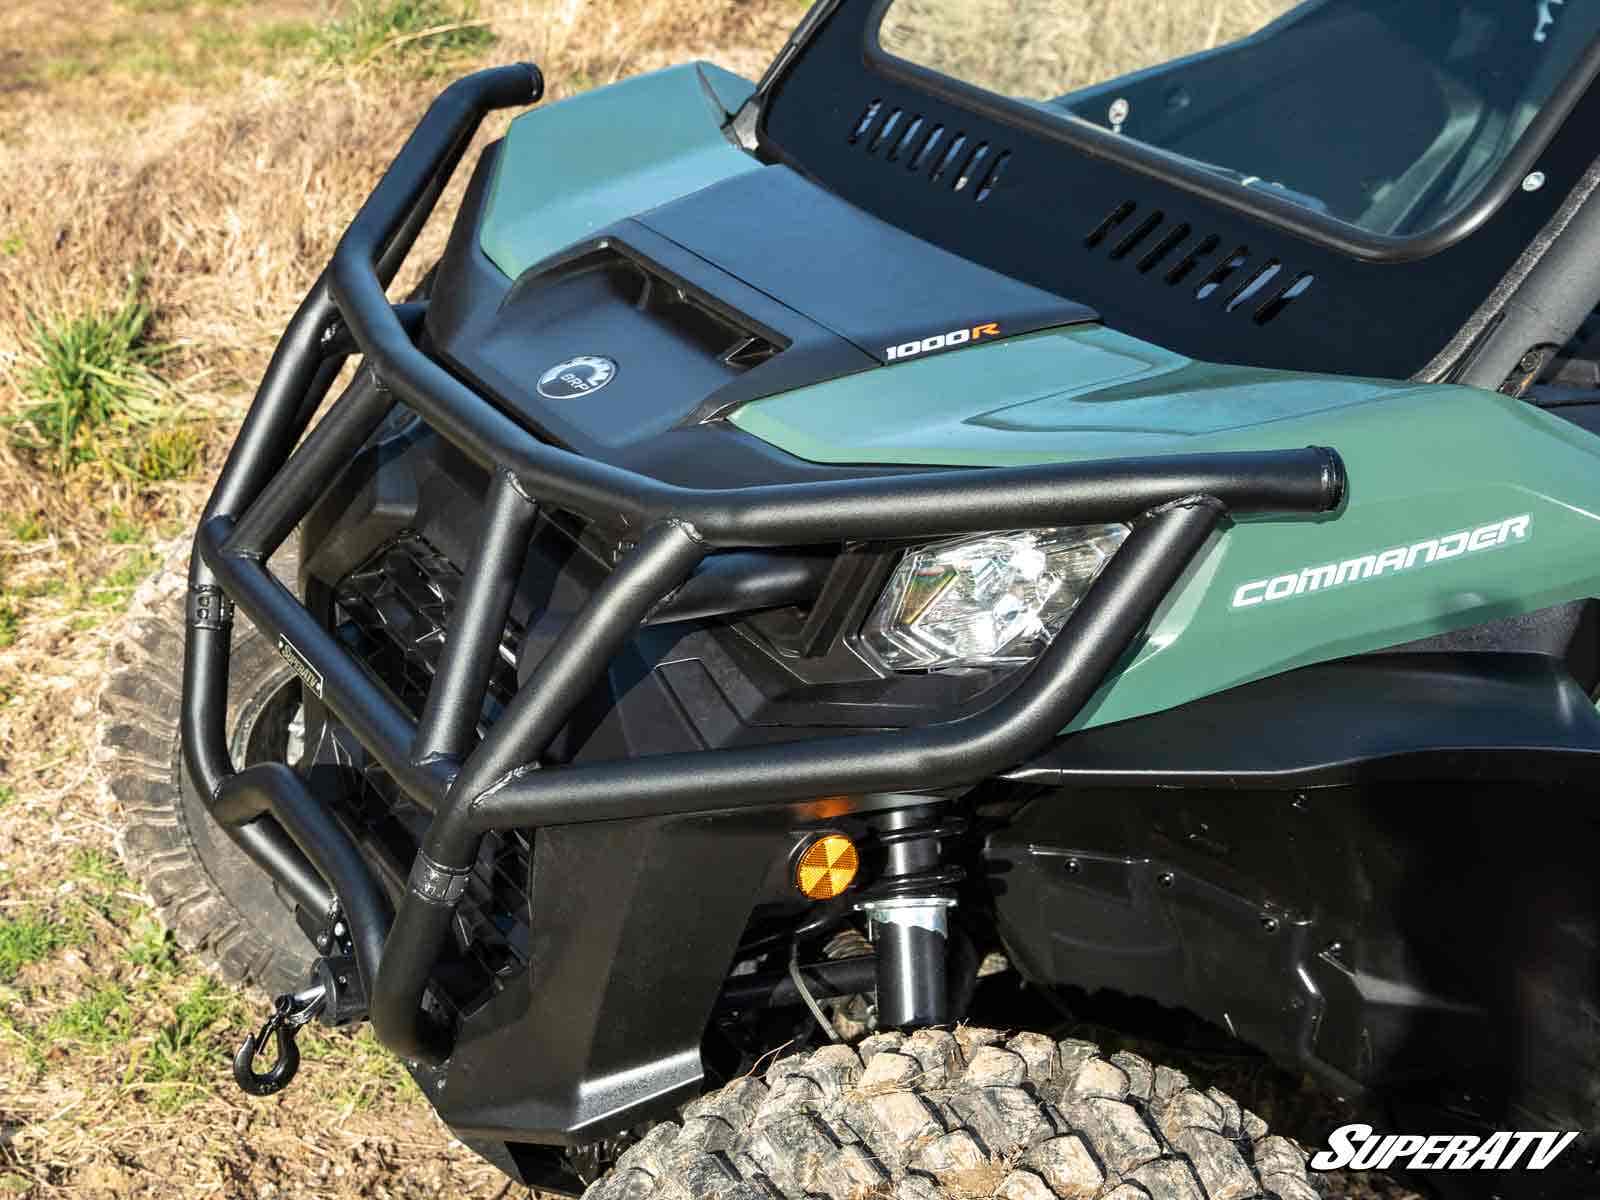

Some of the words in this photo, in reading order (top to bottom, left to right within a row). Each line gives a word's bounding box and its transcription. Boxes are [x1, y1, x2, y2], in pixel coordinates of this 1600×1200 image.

[886, 322, 1001, 360] 1000R
[561, 373, 591, 391] BRP
[1231, 513, 1531, 608] COMMANDER
